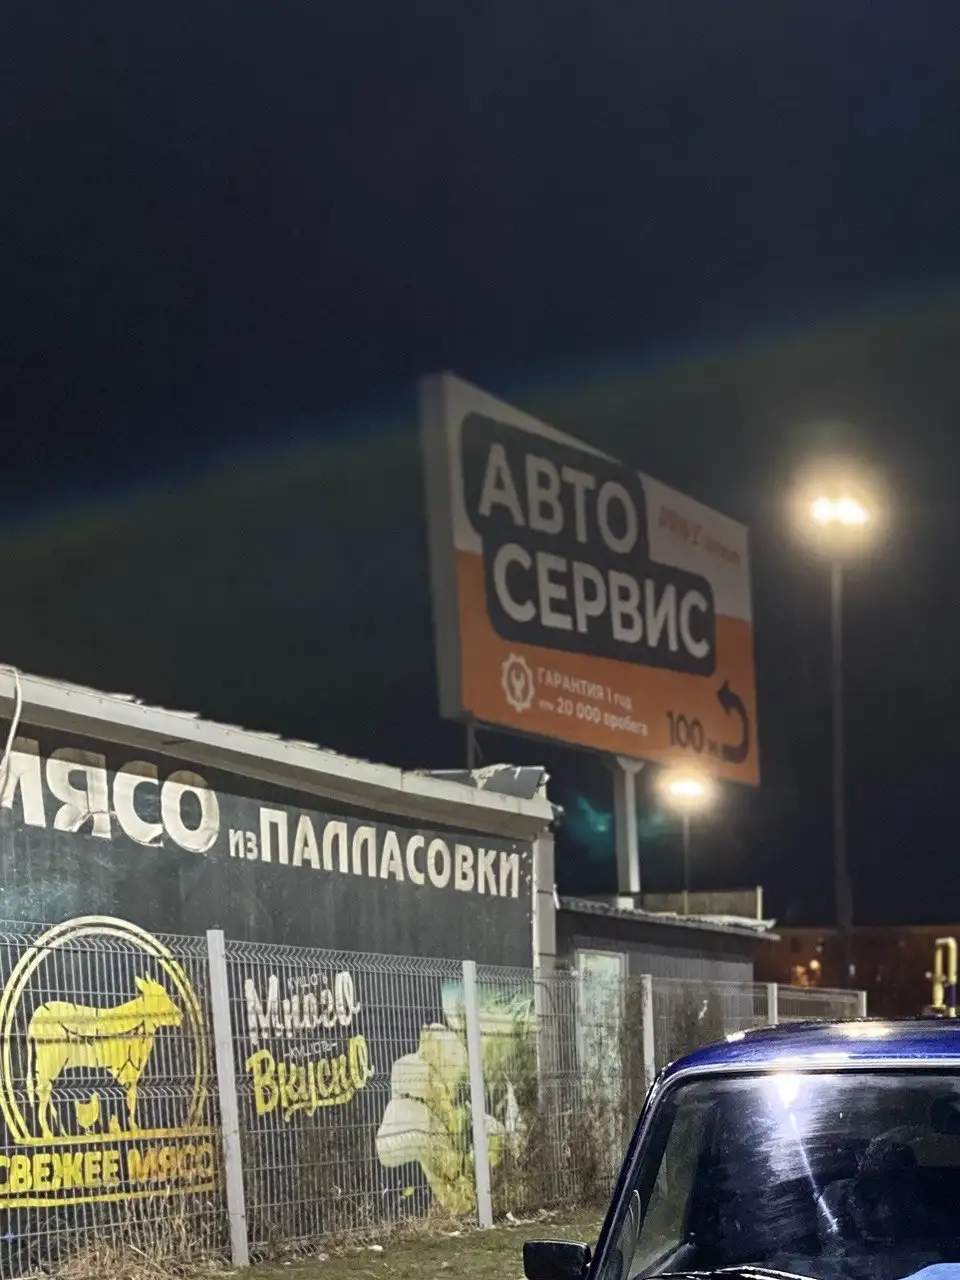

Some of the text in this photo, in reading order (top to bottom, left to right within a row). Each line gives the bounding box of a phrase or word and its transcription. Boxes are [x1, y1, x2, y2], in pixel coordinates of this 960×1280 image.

[478, 443, 637, 554] АВТО
[493, 543, 711, 658] СЕРВИС
[537, 667, 604, 700] ГАРАНТИЯ
[556, 696, 574, 716] 20
[575, 702, 601, 724] 000
[666, 710, 704, 753] 100
[0, 736, 220, 853] МЯСО
[259, 807, 520, 898] ПАЛЛАСОВКИ
[127, 1142, 215, 1184] МЯСО
